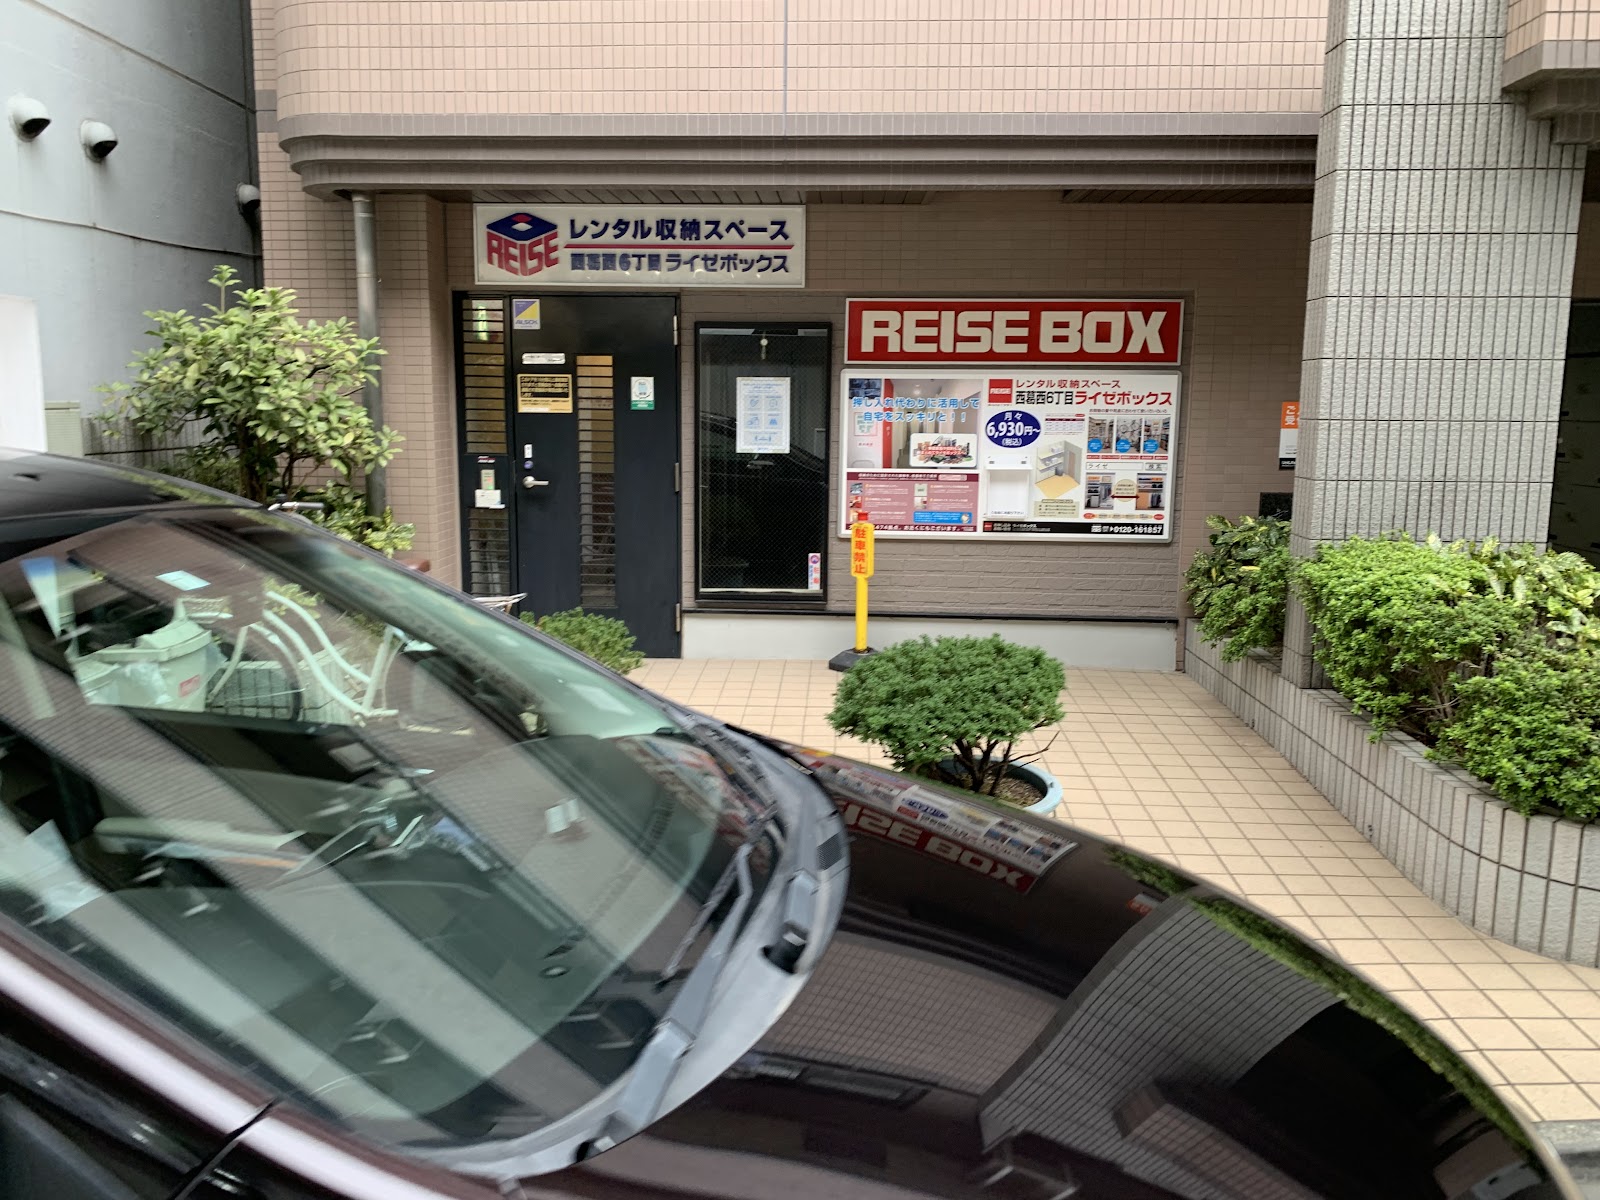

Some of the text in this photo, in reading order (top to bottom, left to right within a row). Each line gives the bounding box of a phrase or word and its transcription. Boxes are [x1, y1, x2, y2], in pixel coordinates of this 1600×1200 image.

[569, 219, 790, 241] レンタル収納スペース
[486, 231, 560, 277] REISE
[860, 310, 1167, 354] REISE BOX
[1016, 379, 1121, 389] レンタル収納スペース
[852, 398, 980, 408] 押し入れ代わりに活用して
[1015, 390, 1173, 406] 西葛西6丁目ライゼボックス
[1004, 412, 1023, 421] 月々
[854, 528, 867, 574] 駐車禁止
